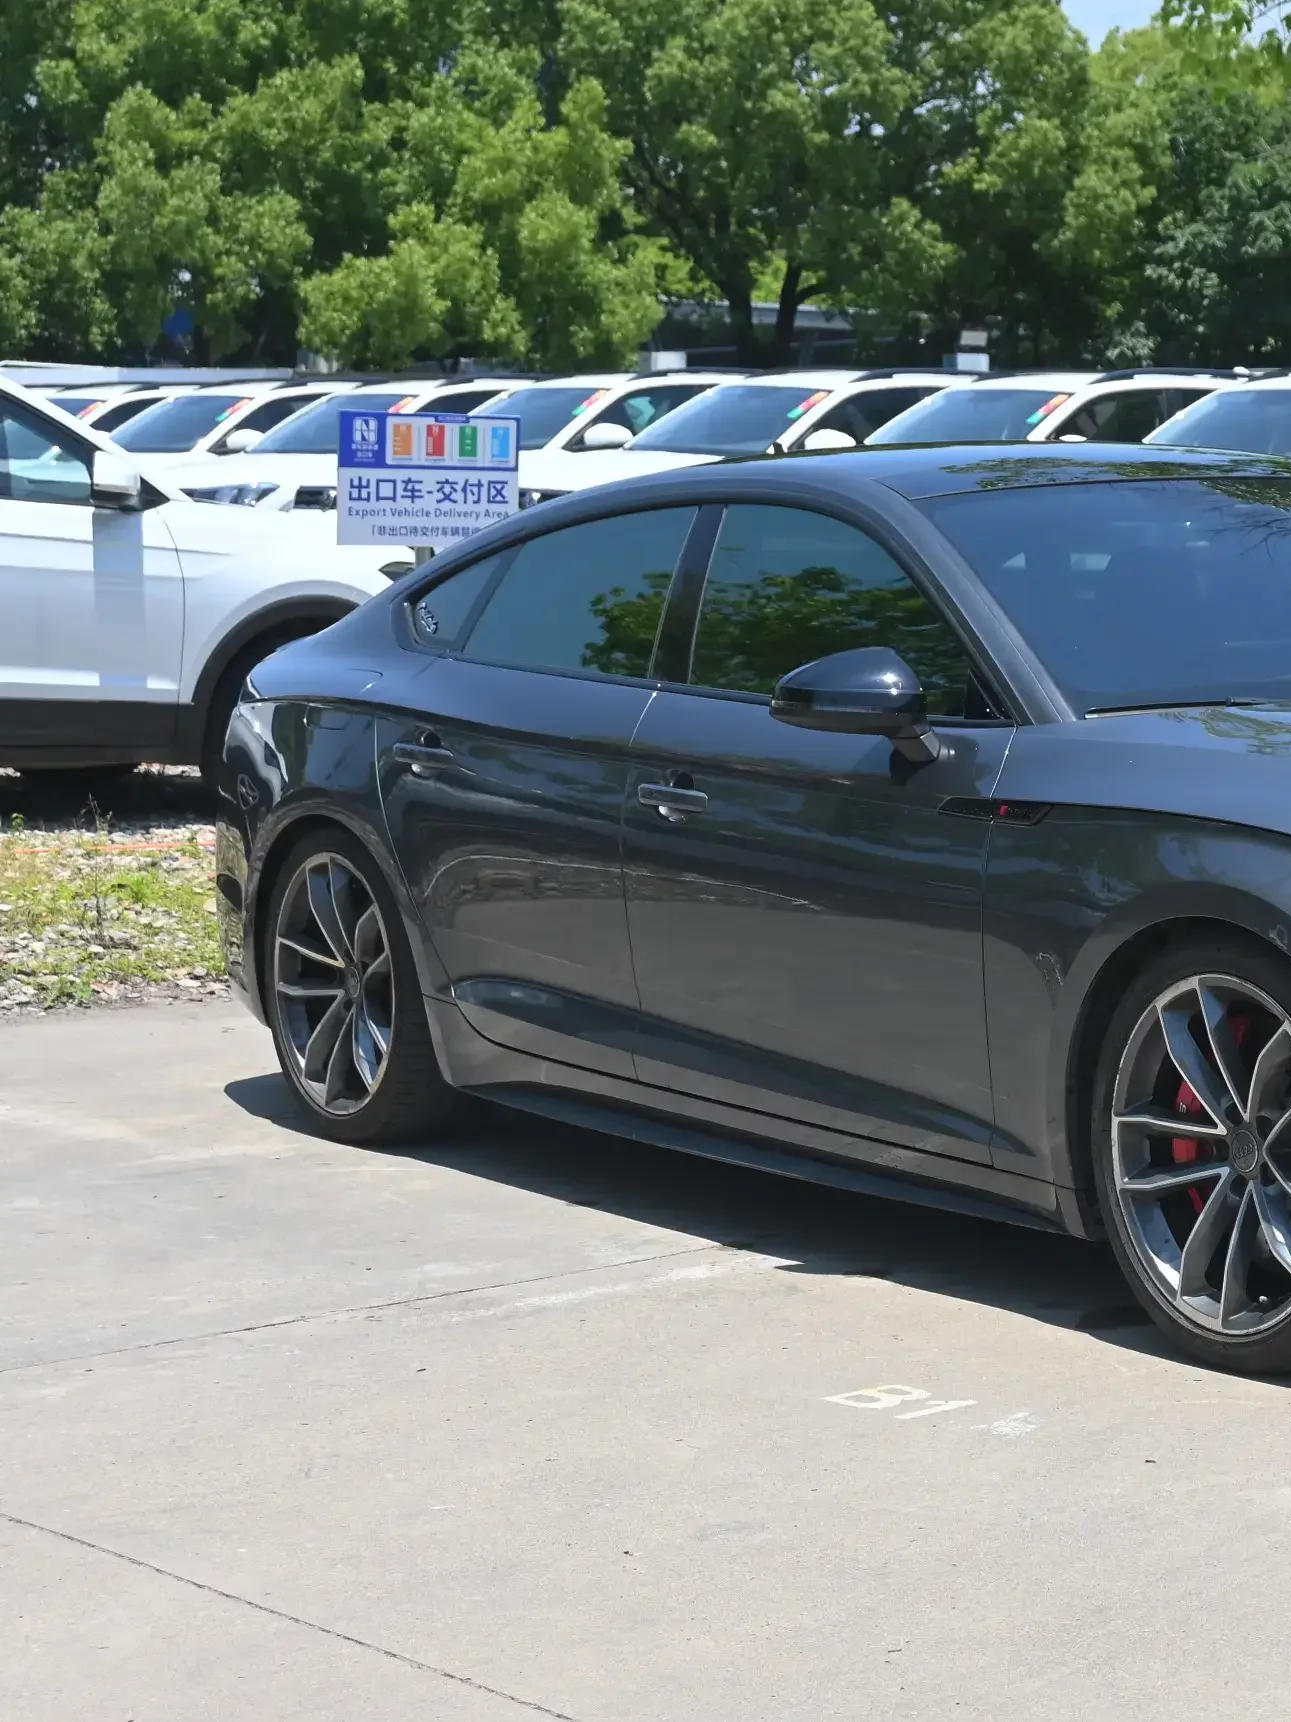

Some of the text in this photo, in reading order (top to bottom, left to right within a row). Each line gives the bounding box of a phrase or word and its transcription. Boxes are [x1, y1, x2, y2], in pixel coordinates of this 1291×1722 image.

[348, 476, 509, 504] 出口车-交付区
[348, 506, 509, 521] Export Vehicle Delivery Area
